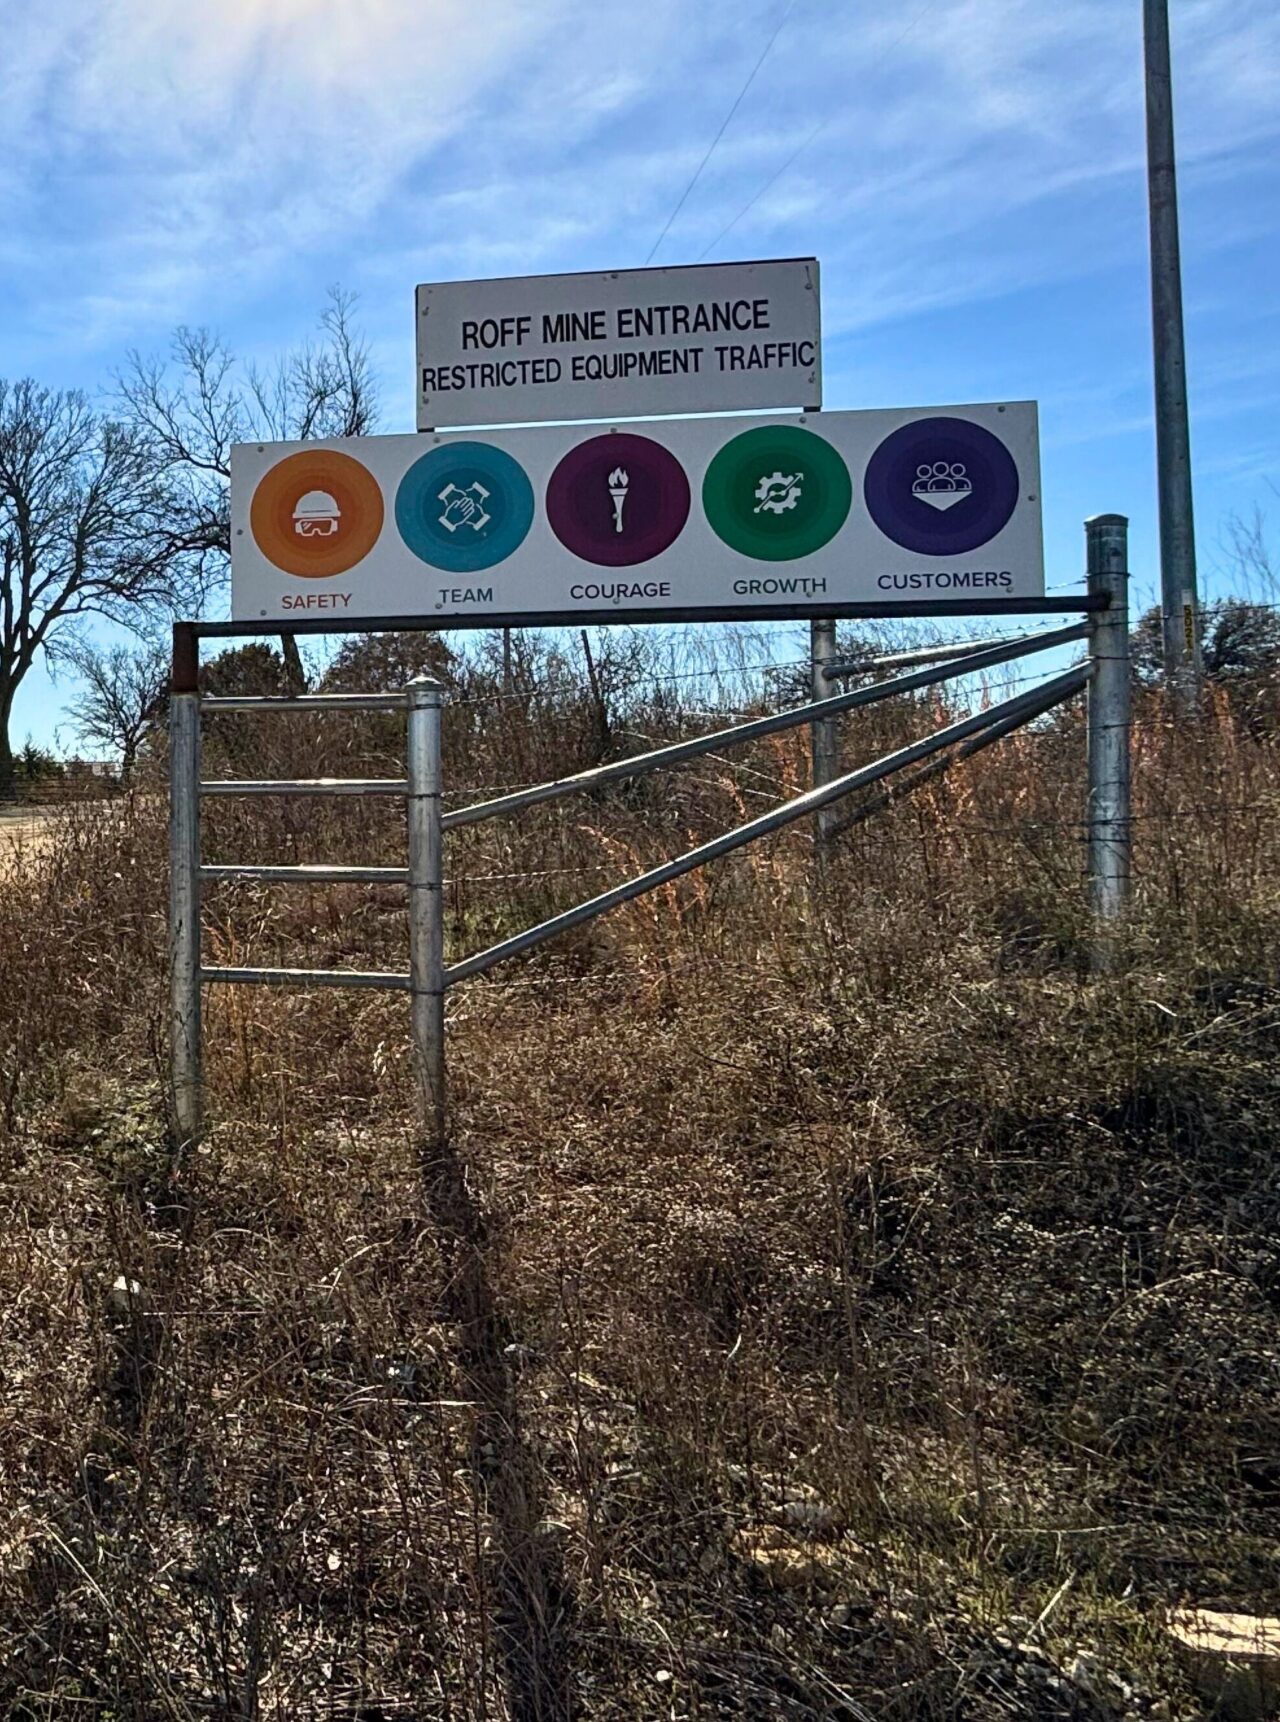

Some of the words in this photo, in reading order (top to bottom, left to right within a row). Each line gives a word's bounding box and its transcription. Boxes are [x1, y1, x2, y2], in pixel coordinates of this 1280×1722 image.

[461, 316, 531, 351] ROFF
[542, 311, 607, 344] MINE
[617, 299, 771, 338] ENTRANCE
[422, 358, 562, 393] RESTRICTED
[571, 347, 704, 381] EQUIPMENT
[715, 341, 816, 371] TRAFFIC
[733, 578, 827, 594] GROWTH
[877, 571, 1012, 590] CUSTOMERS
[439, 588, 493, 604] TEAM
[569, 582, 671, 600] COURAGE
[281, 593, 353, 610] SAFETY
